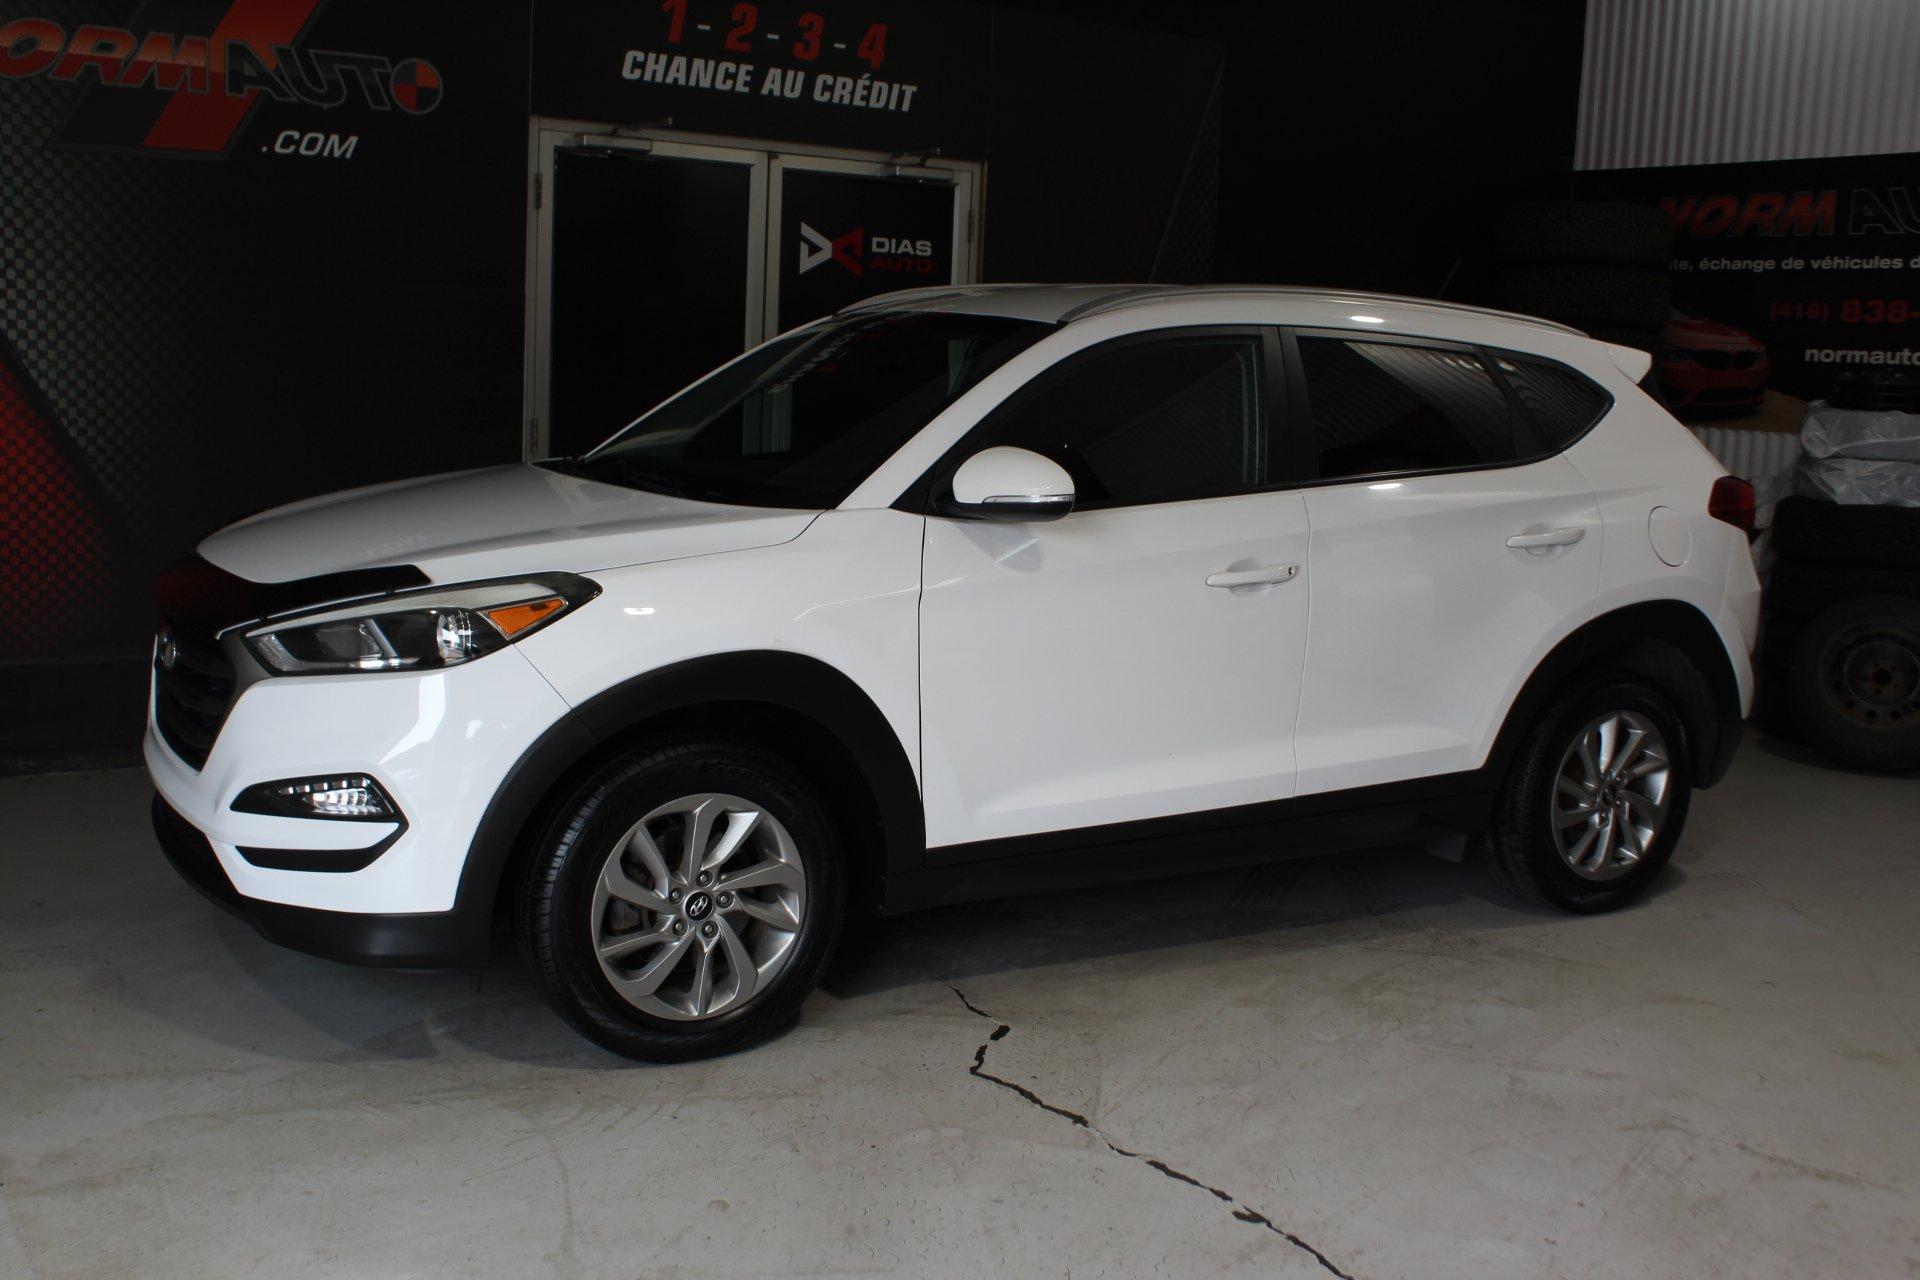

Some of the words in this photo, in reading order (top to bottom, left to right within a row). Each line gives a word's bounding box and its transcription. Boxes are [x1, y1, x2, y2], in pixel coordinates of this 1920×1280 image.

[621, 49, 754, 93] CHANCE
[760, 67, 806, 99] AU
[813, 72, 918, 113] CRÉDIT
[871, 236, 932, 256] DIAS
[1698, 257, 1775, 272] échange
[1781, 256, 1804, 270] de
[1811, 255, 1904, 270] véhicules
